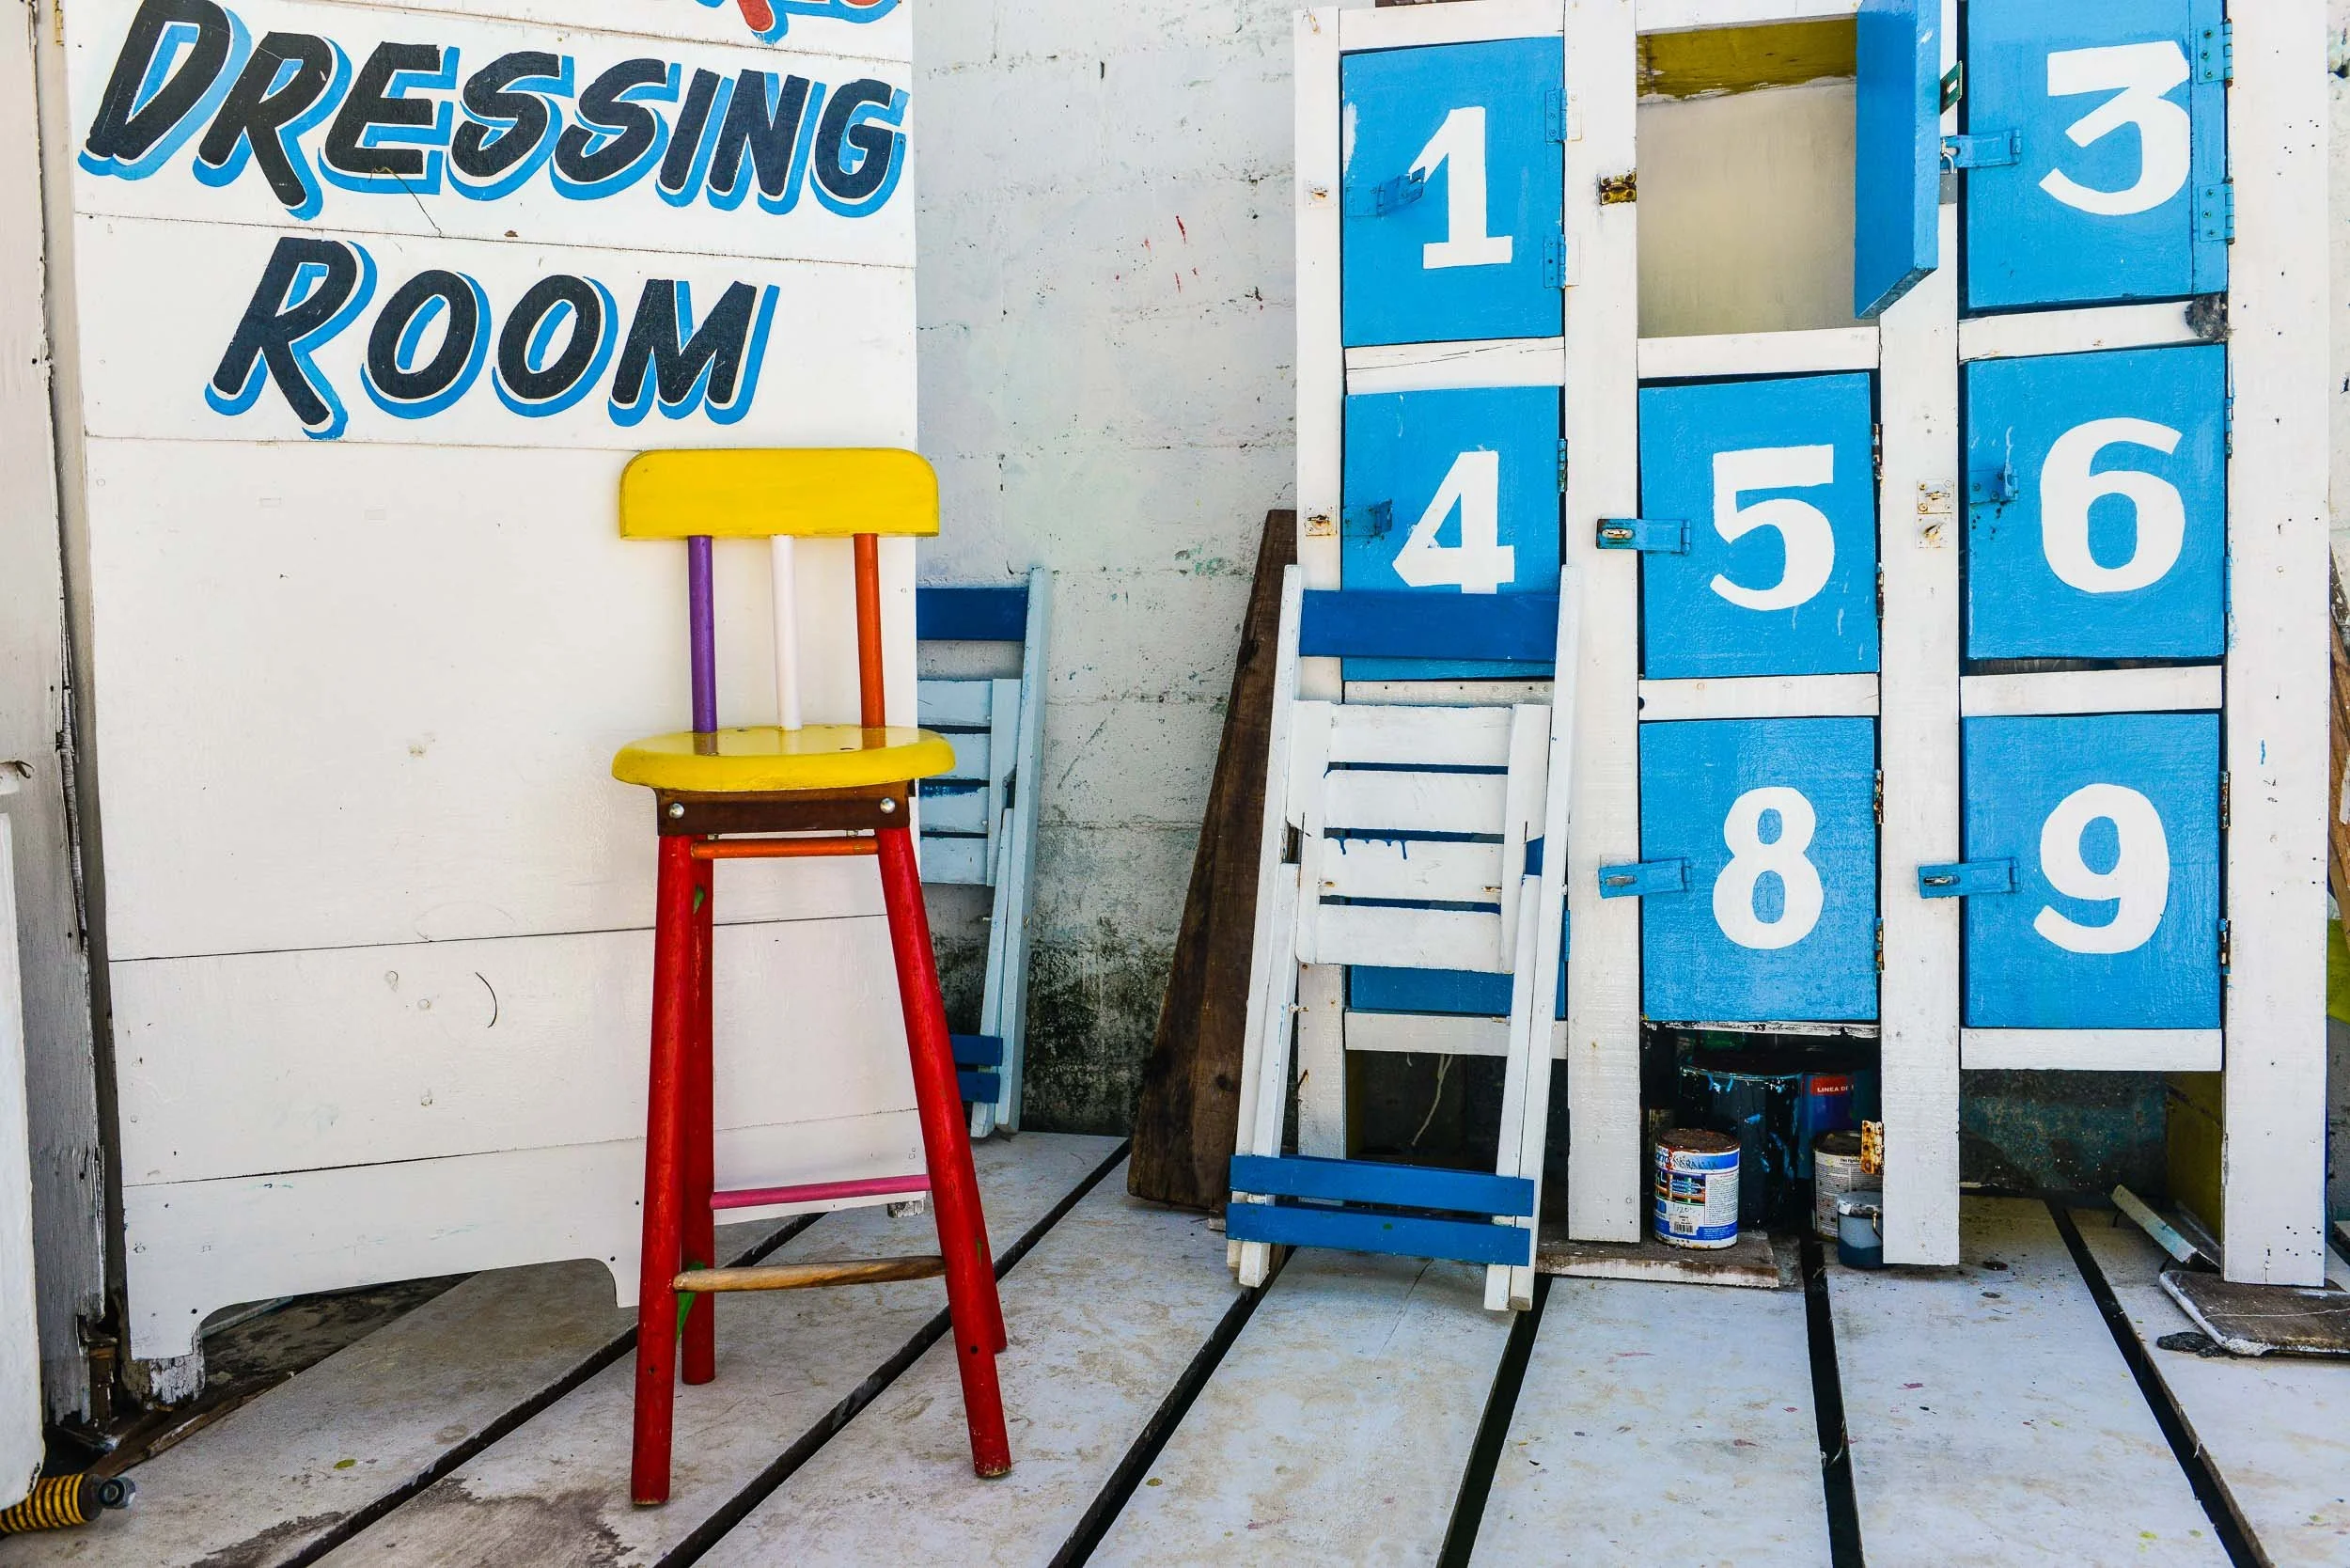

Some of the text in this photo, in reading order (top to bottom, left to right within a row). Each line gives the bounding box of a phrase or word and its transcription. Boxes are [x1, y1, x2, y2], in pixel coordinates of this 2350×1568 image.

[78, 0, 909, 221] DRESSING
[1409, 106, 1512, 268] 1
[2038, 40, 2191, 215] 3
[205, 237, 781, 440] ROOM
[1392, 450, 1515, 594] 4
[1710, 444, 1835, 611] 5
[2041, 417, 2186, 593] 6
[1713, 786, 1825, 950] 8
[2033, 783, 2170, 954] 9
